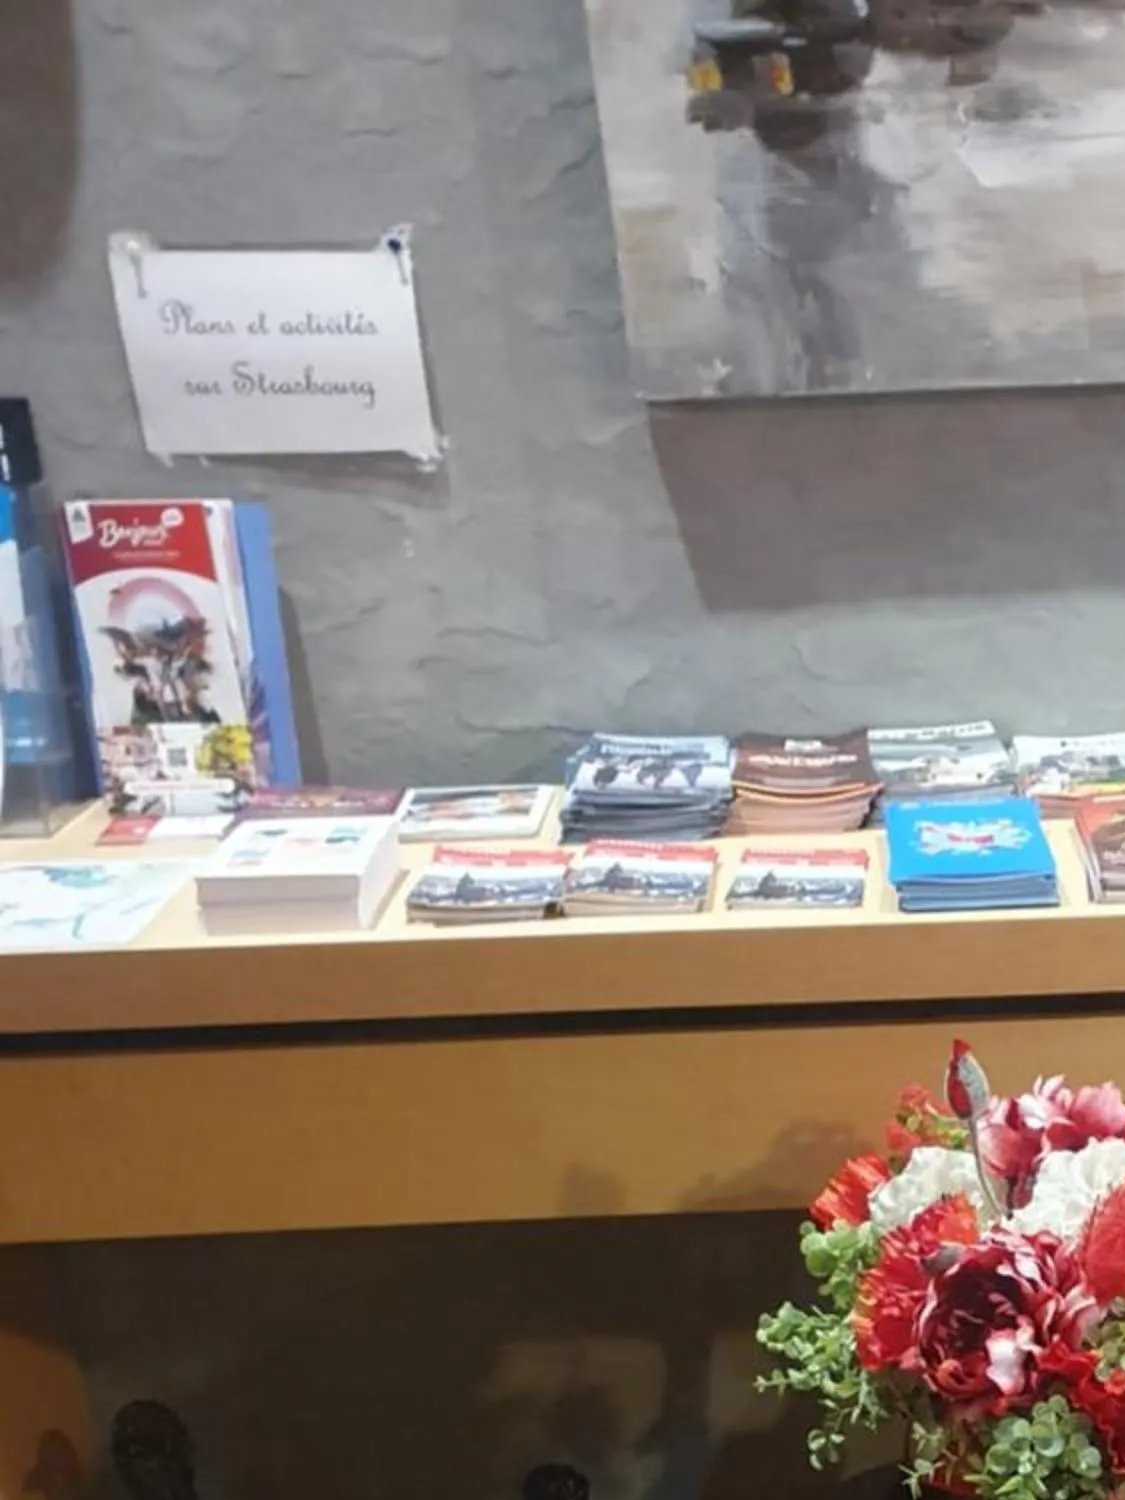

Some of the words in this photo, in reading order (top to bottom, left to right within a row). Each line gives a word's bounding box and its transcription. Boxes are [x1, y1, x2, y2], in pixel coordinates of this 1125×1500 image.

[158, 298, 235, 336] Plans
[246, 311, 270, 336] et
[279, 306, 379, 336] activités
[185, 379, 223, 396] sur
[232, 360, 376, 409] Strasbourg
